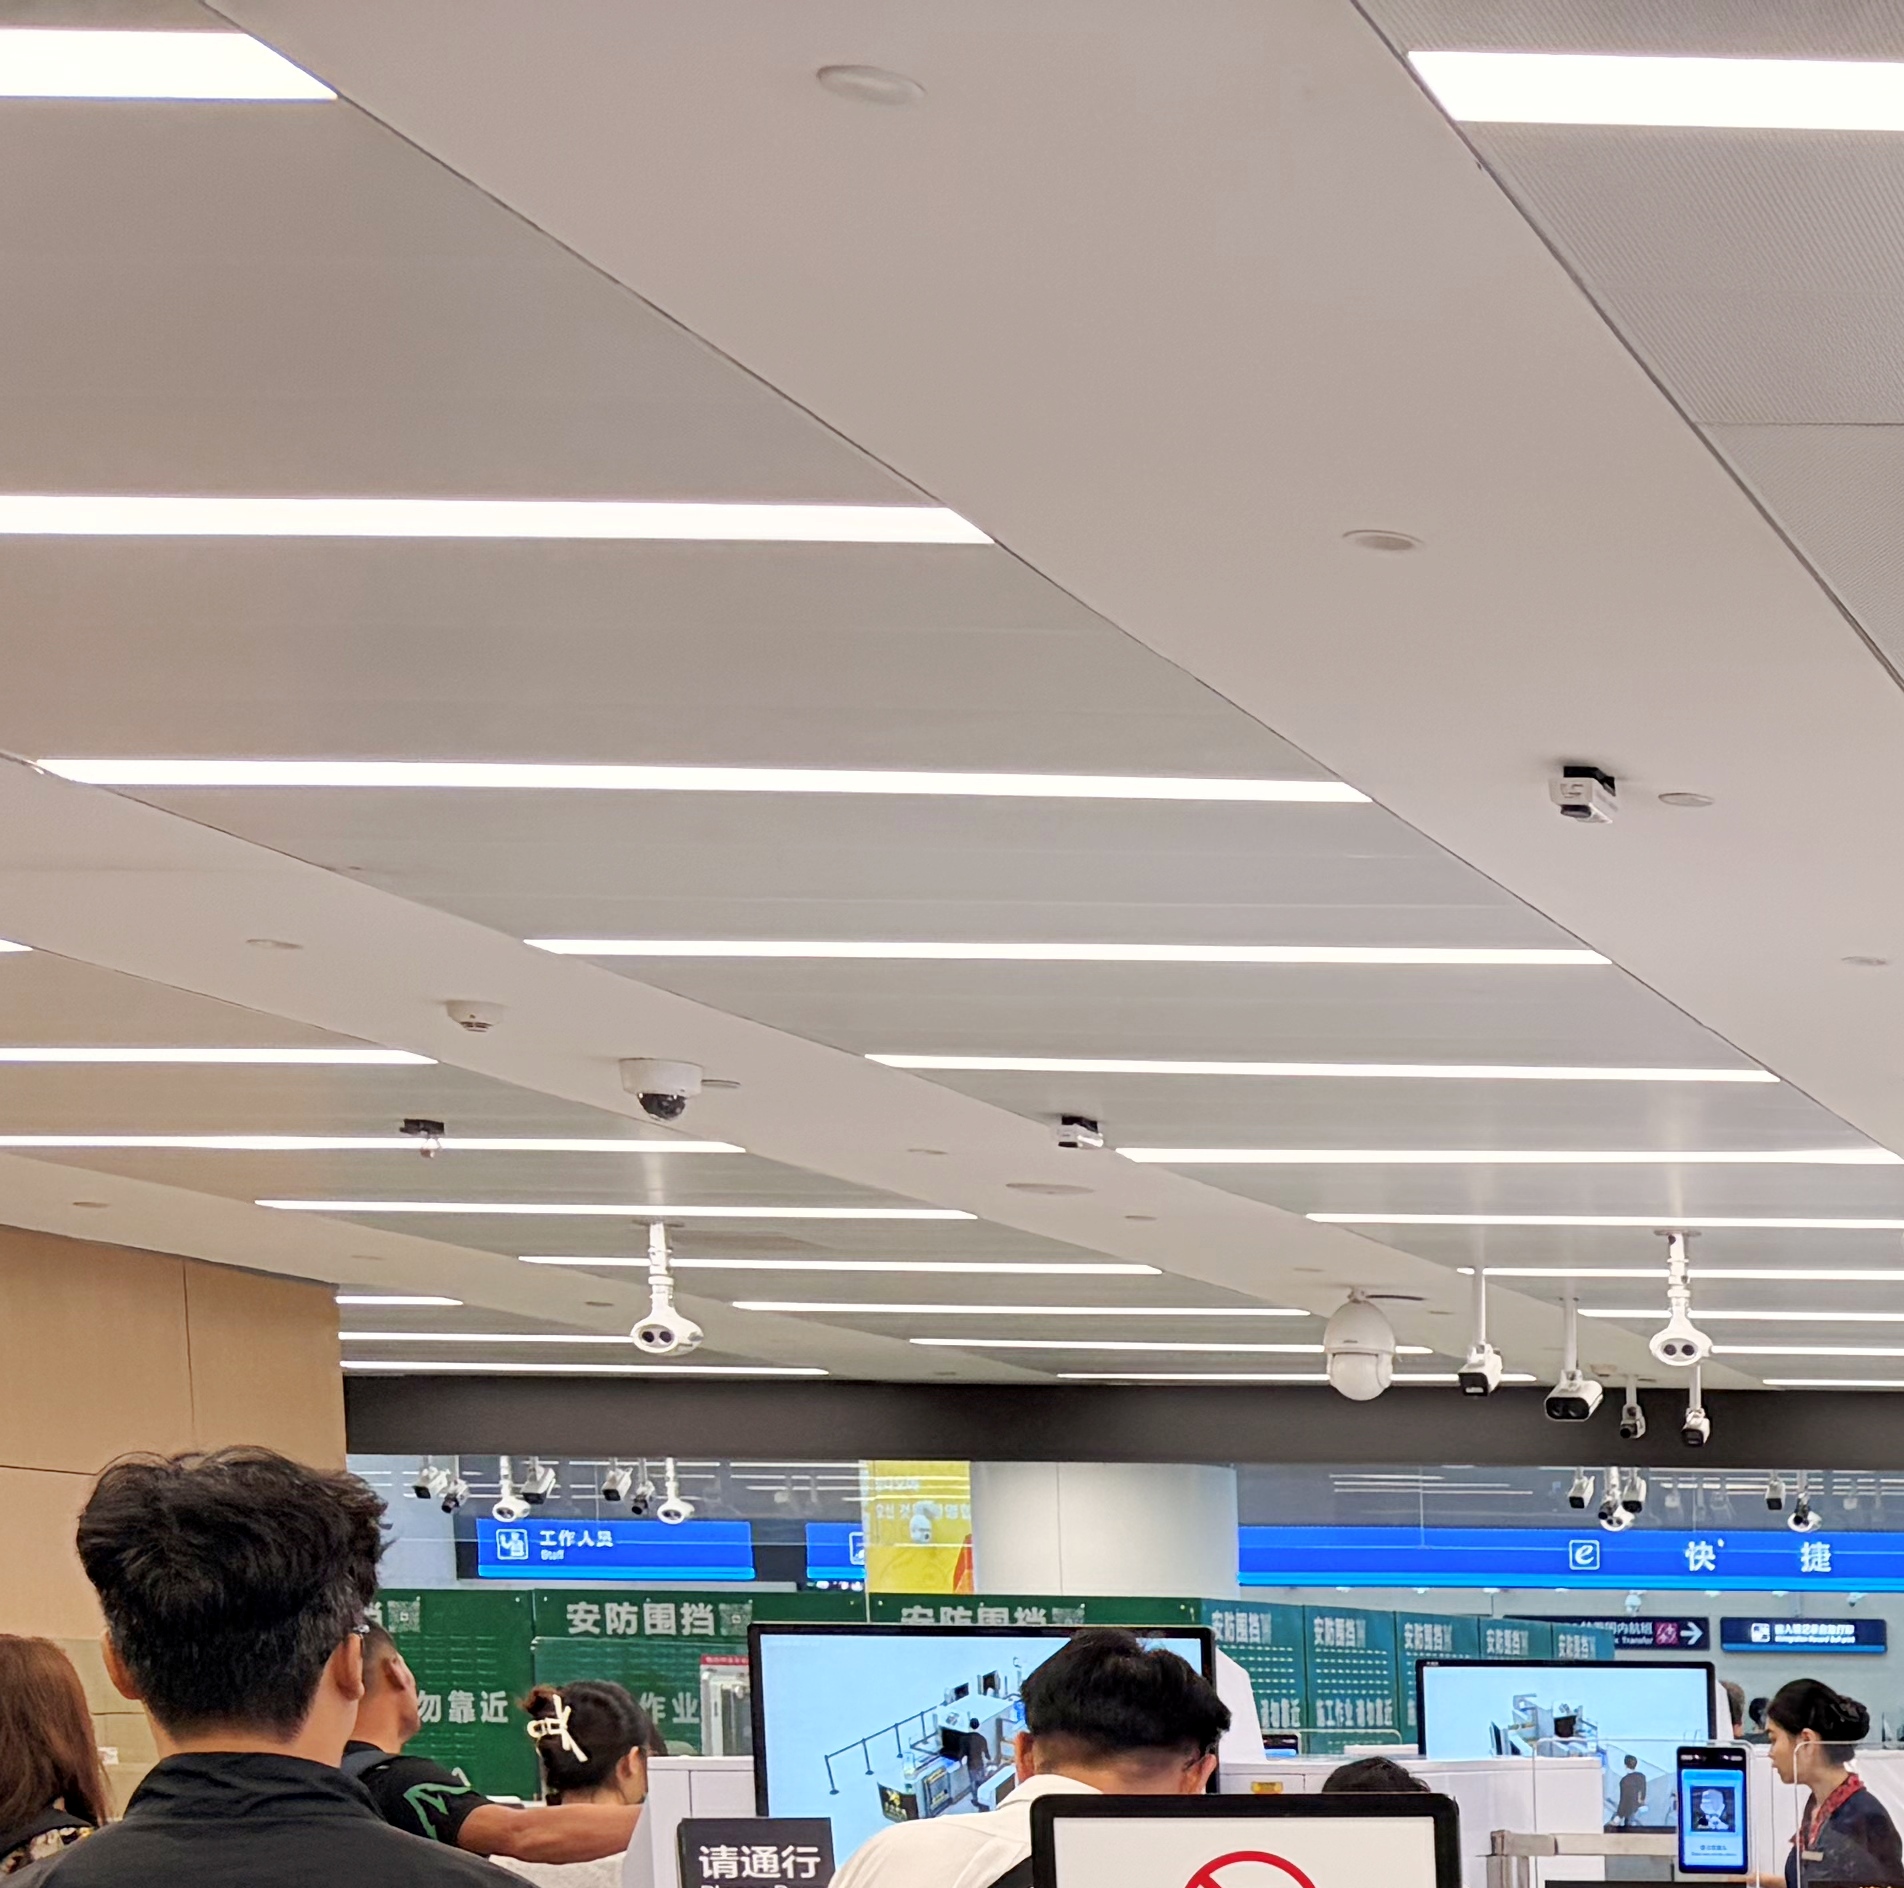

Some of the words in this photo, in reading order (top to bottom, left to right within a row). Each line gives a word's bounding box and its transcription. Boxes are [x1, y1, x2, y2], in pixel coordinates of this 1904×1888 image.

[540, 1530, 614, 1547] 工作人员
[567, 1602, 716, 1636] 安防围挡
[417, 1689, 509, 1724] 勿靠近
[640, 1691, 700, 1725] 作业
[698, 1844, 821, 1880] 请通行
